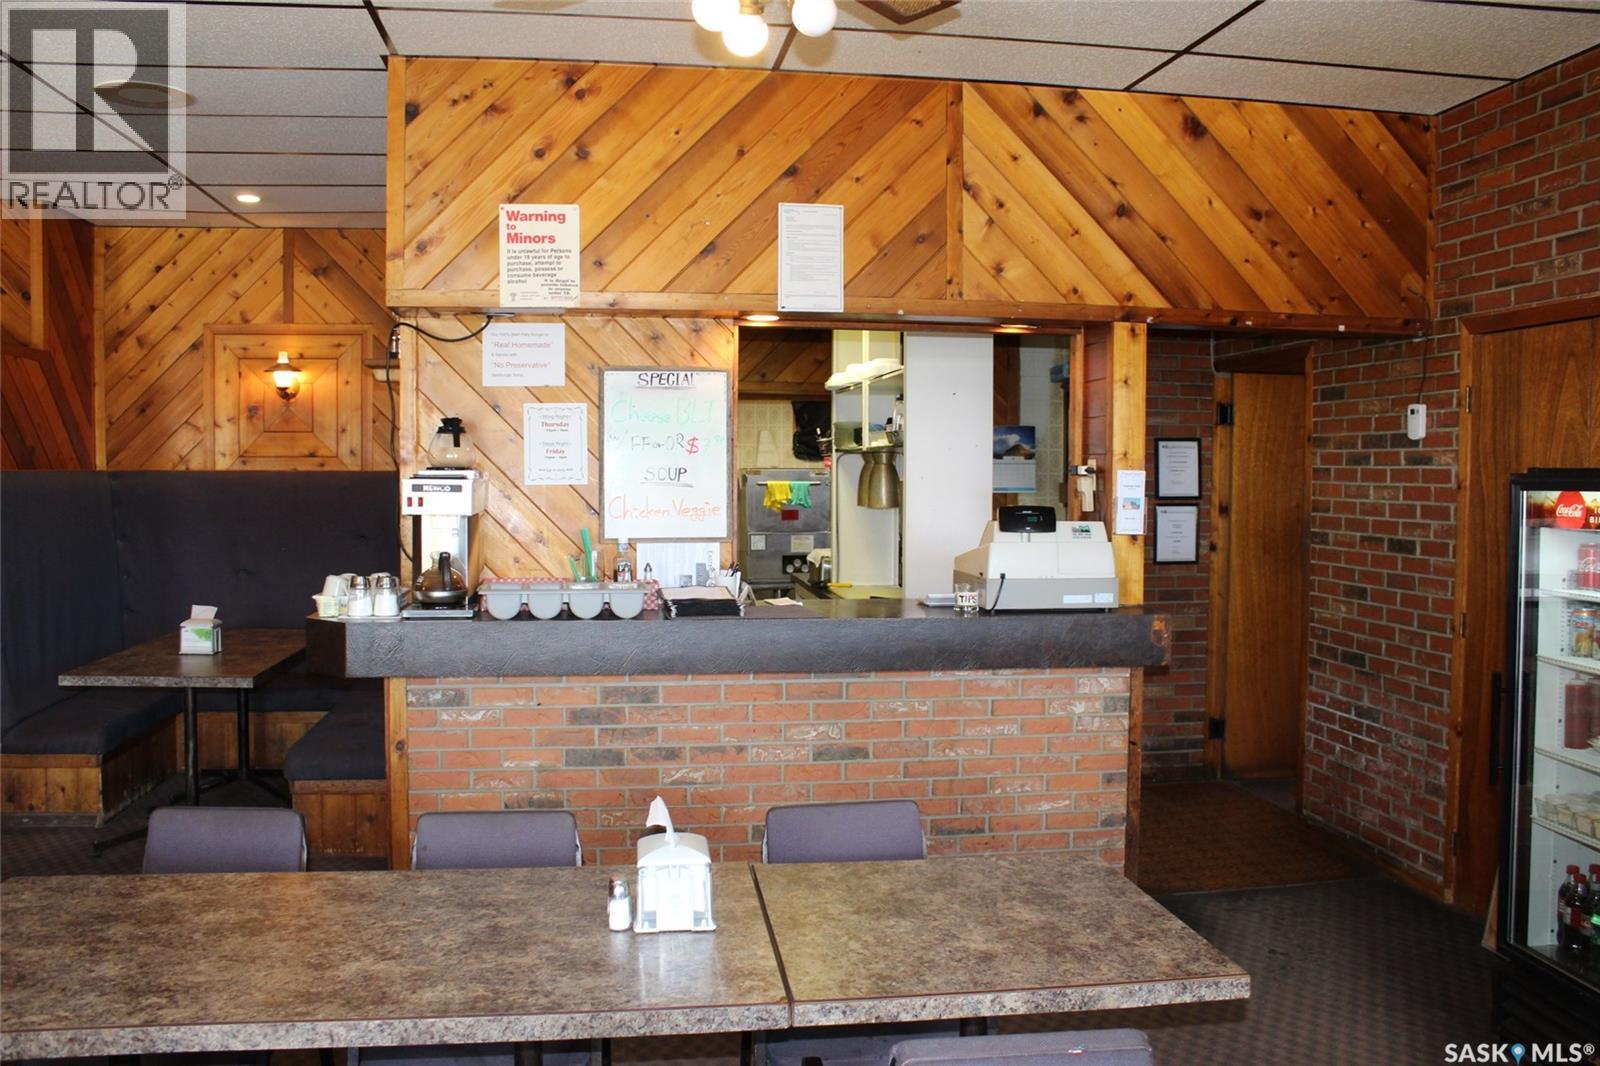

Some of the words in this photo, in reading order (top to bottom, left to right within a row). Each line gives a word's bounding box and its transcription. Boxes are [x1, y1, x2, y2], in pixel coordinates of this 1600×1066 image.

[506, 210, 566, 224] Warning
[506, 232, 556, 244] Minors
[644, 467, 688, 482] SOUP
[608, 493, 671, 520] Chicken
[672, 497, 721, 522] Veggie
[959, 594, 977, 604] TIPS
